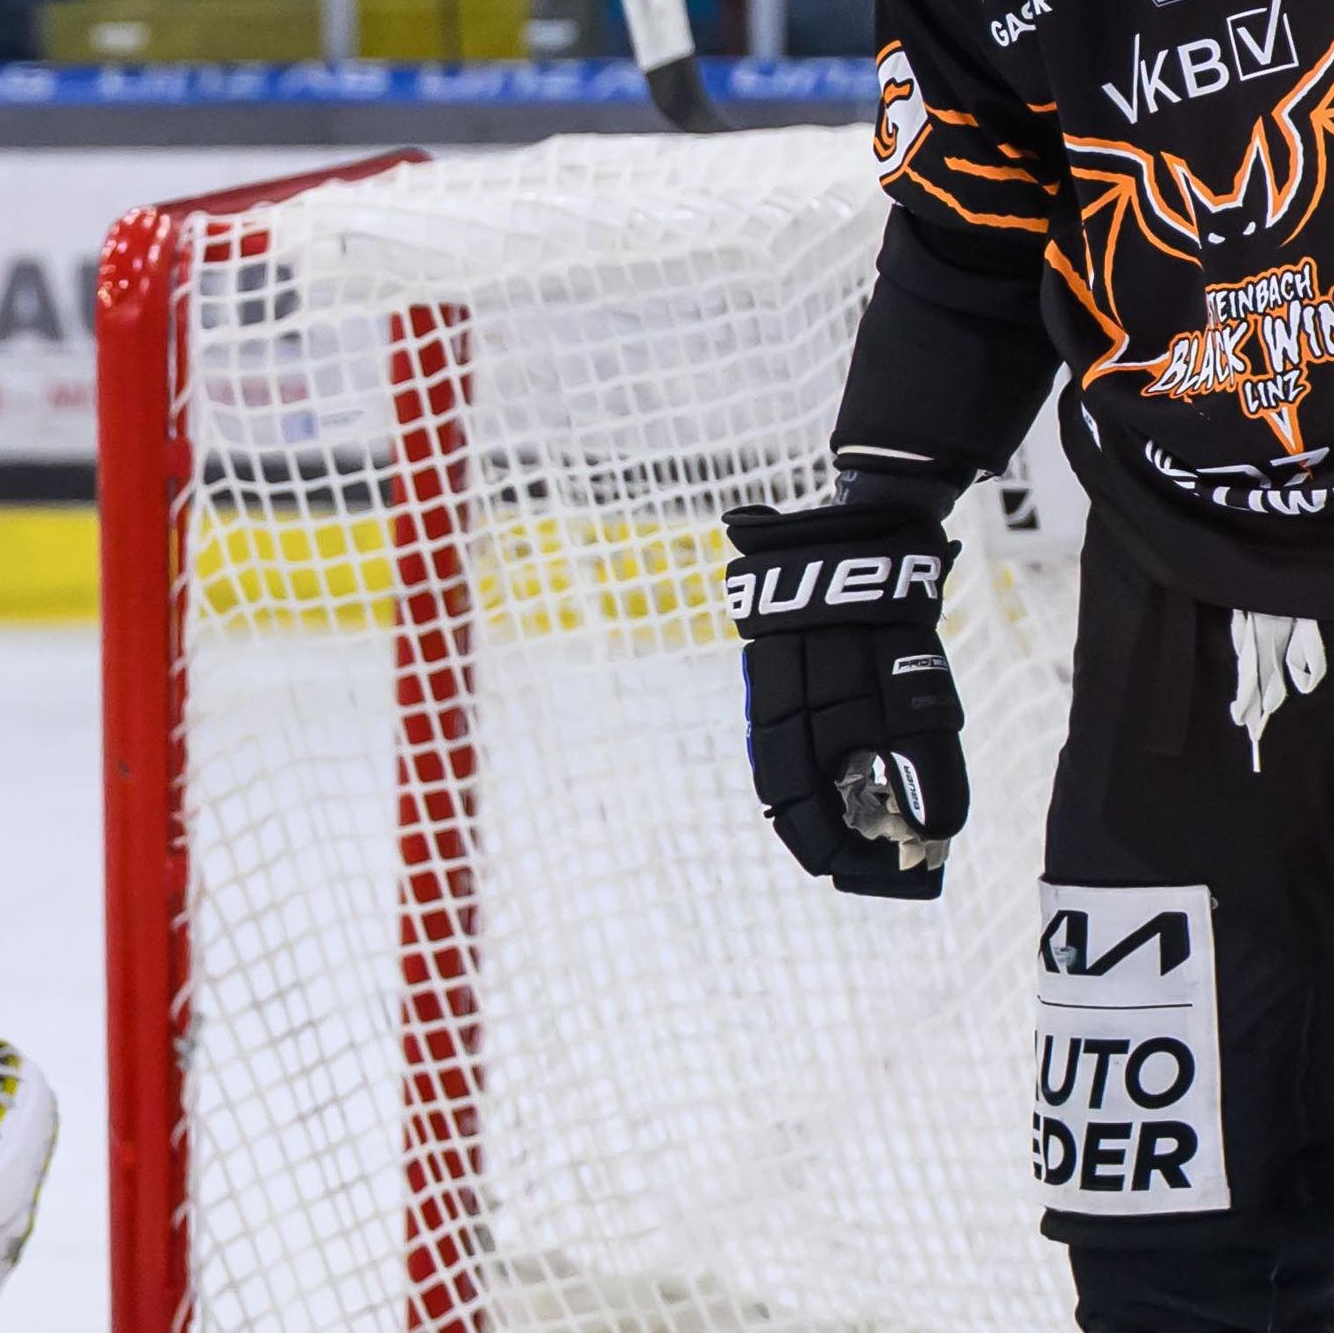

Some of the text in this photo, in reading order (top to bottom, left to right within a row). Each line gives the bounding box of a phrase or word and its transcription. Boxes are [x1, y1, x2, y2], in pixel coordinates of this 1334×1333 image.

[1146, 320, 1249, 398] BLACK
[1242, 366, 1308, 415] LINZ
[1034, 1029, 1196, 1111] UTO
